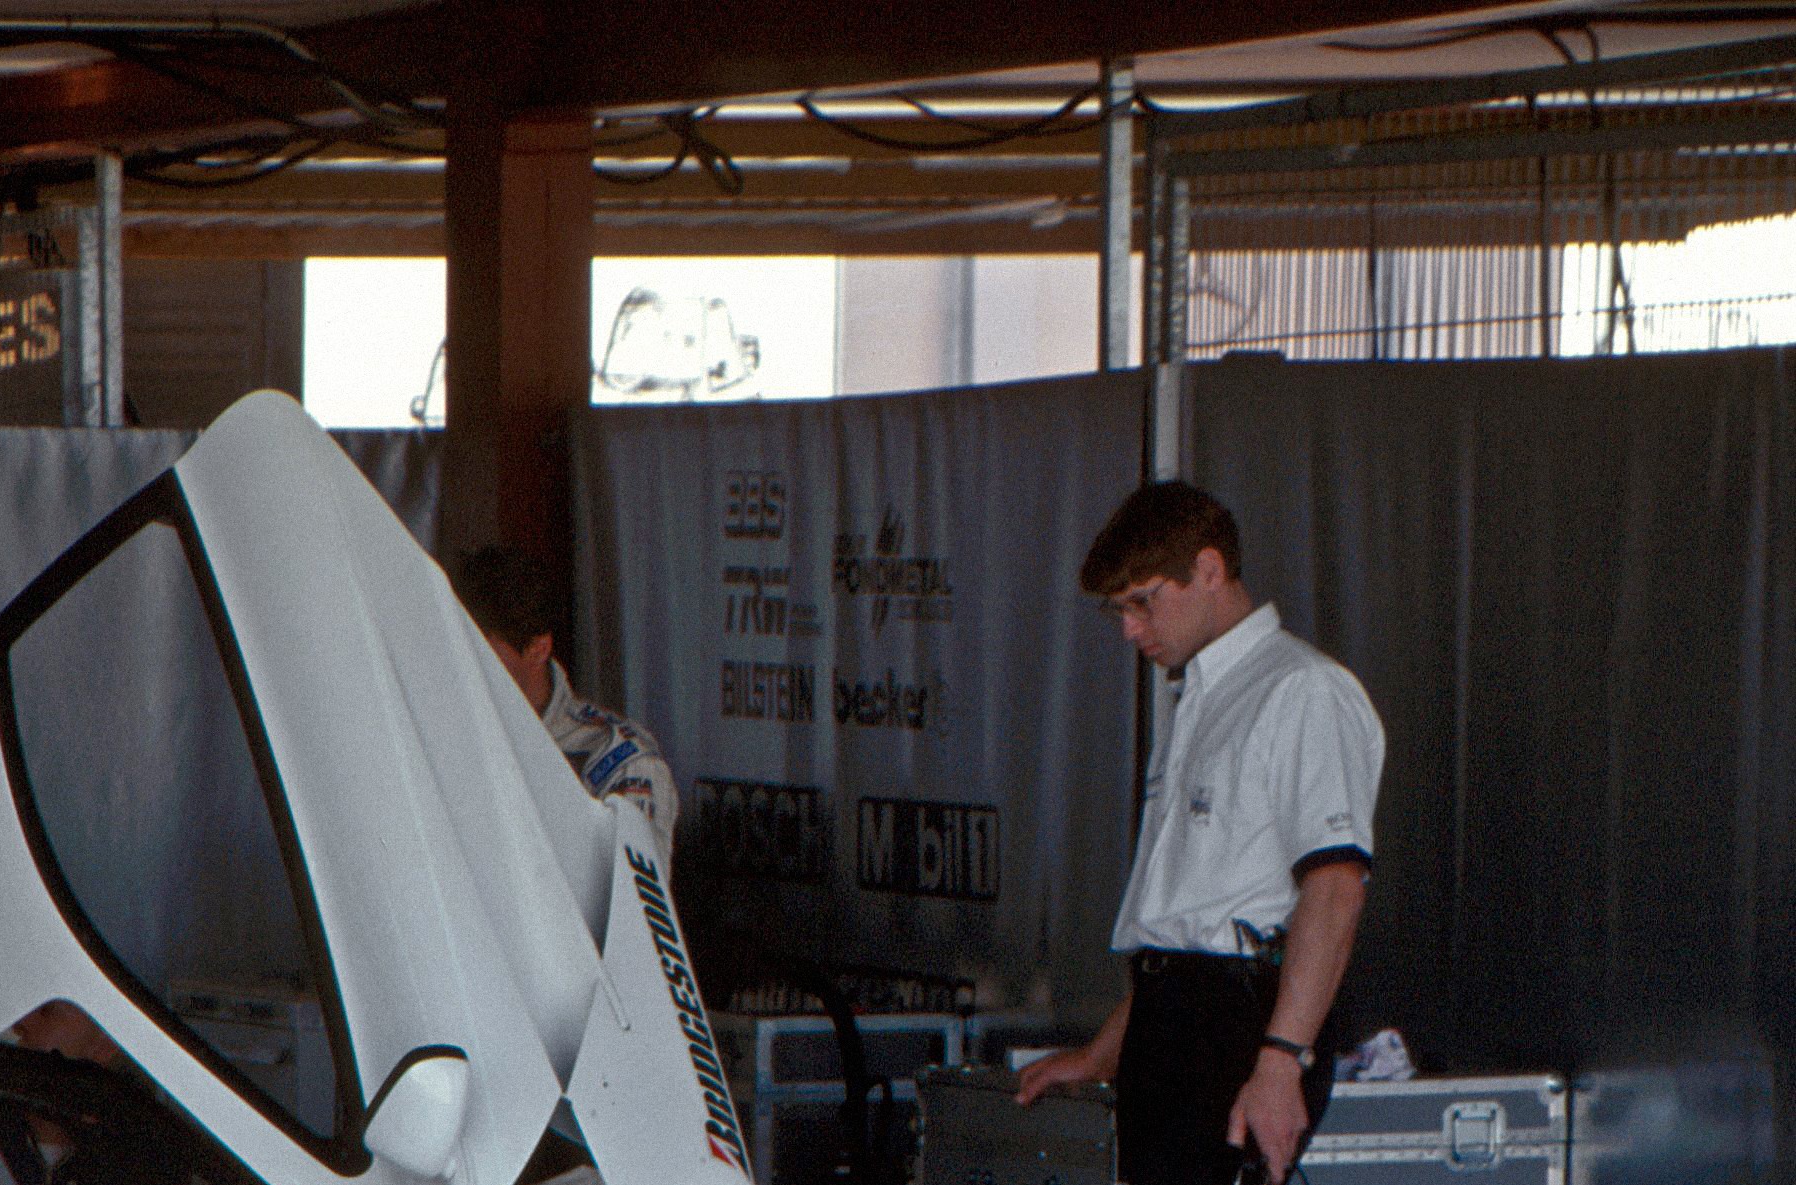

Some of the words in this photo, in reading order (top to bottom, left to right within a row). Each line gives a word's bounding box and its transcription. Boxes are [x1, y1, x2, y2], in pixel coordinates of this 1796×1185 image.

[721, 659, 815, 722] BILSTEIN
[860, 799, 962, 894] Mbil
[625, 845, 748, 1178] BRIDGESTONE
